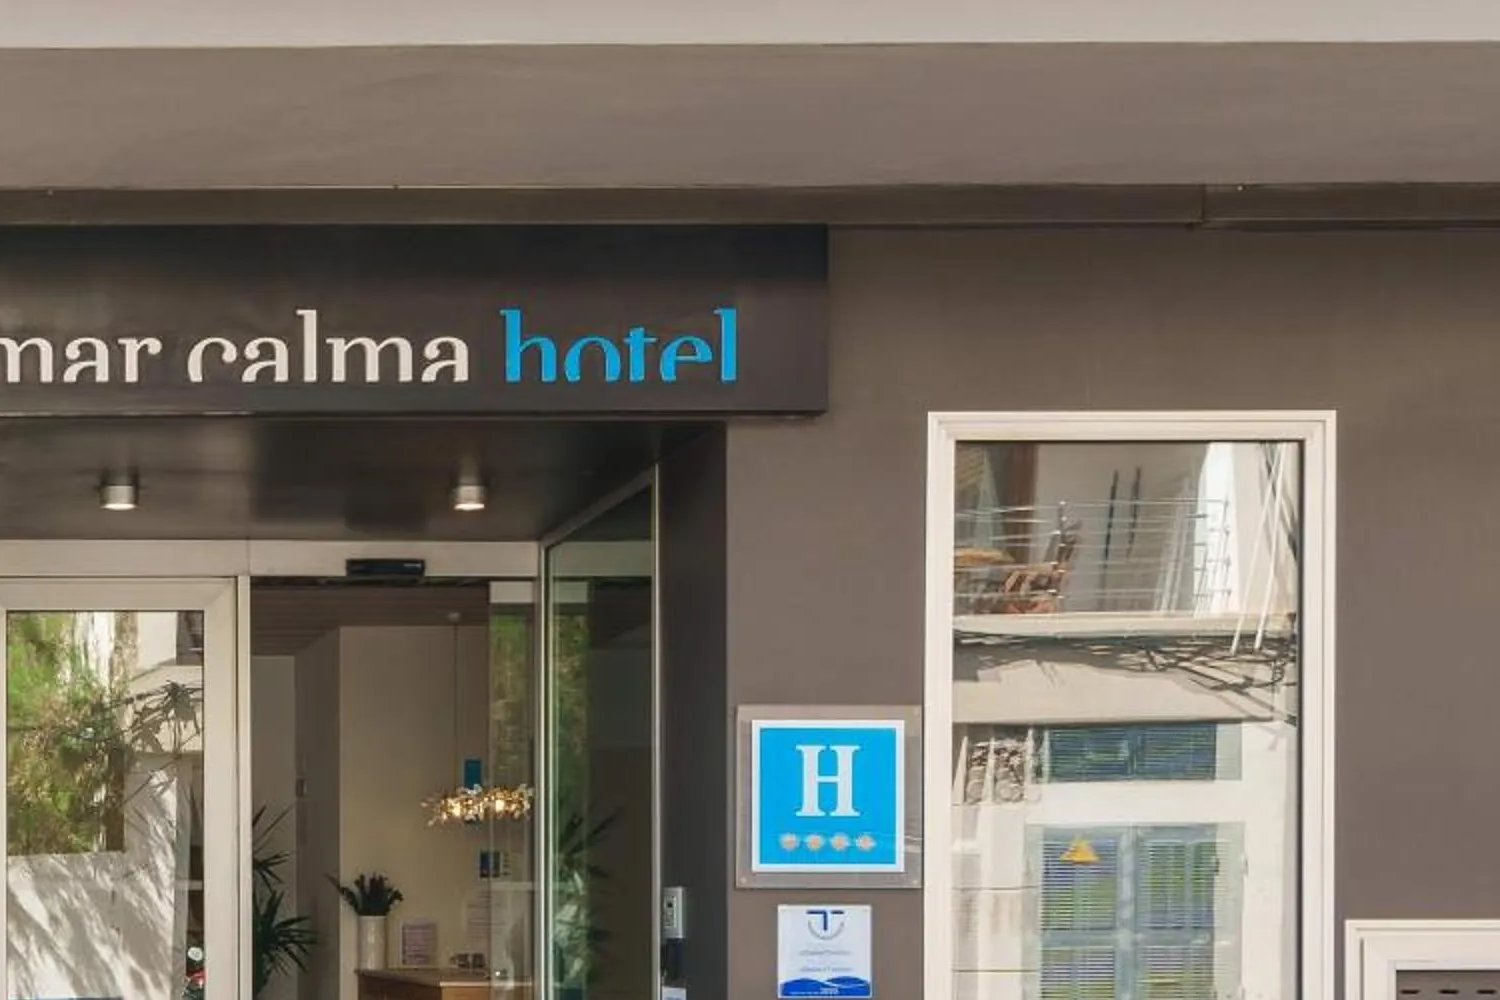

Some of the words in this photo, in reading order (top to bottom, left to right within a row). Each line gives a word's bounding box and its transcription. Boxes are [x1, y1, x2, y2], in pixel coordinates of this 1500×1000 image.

[187, 308, 469, 383] calma
[500, 307, 738, 383] hotel
[795, 743, 861, 817] H
